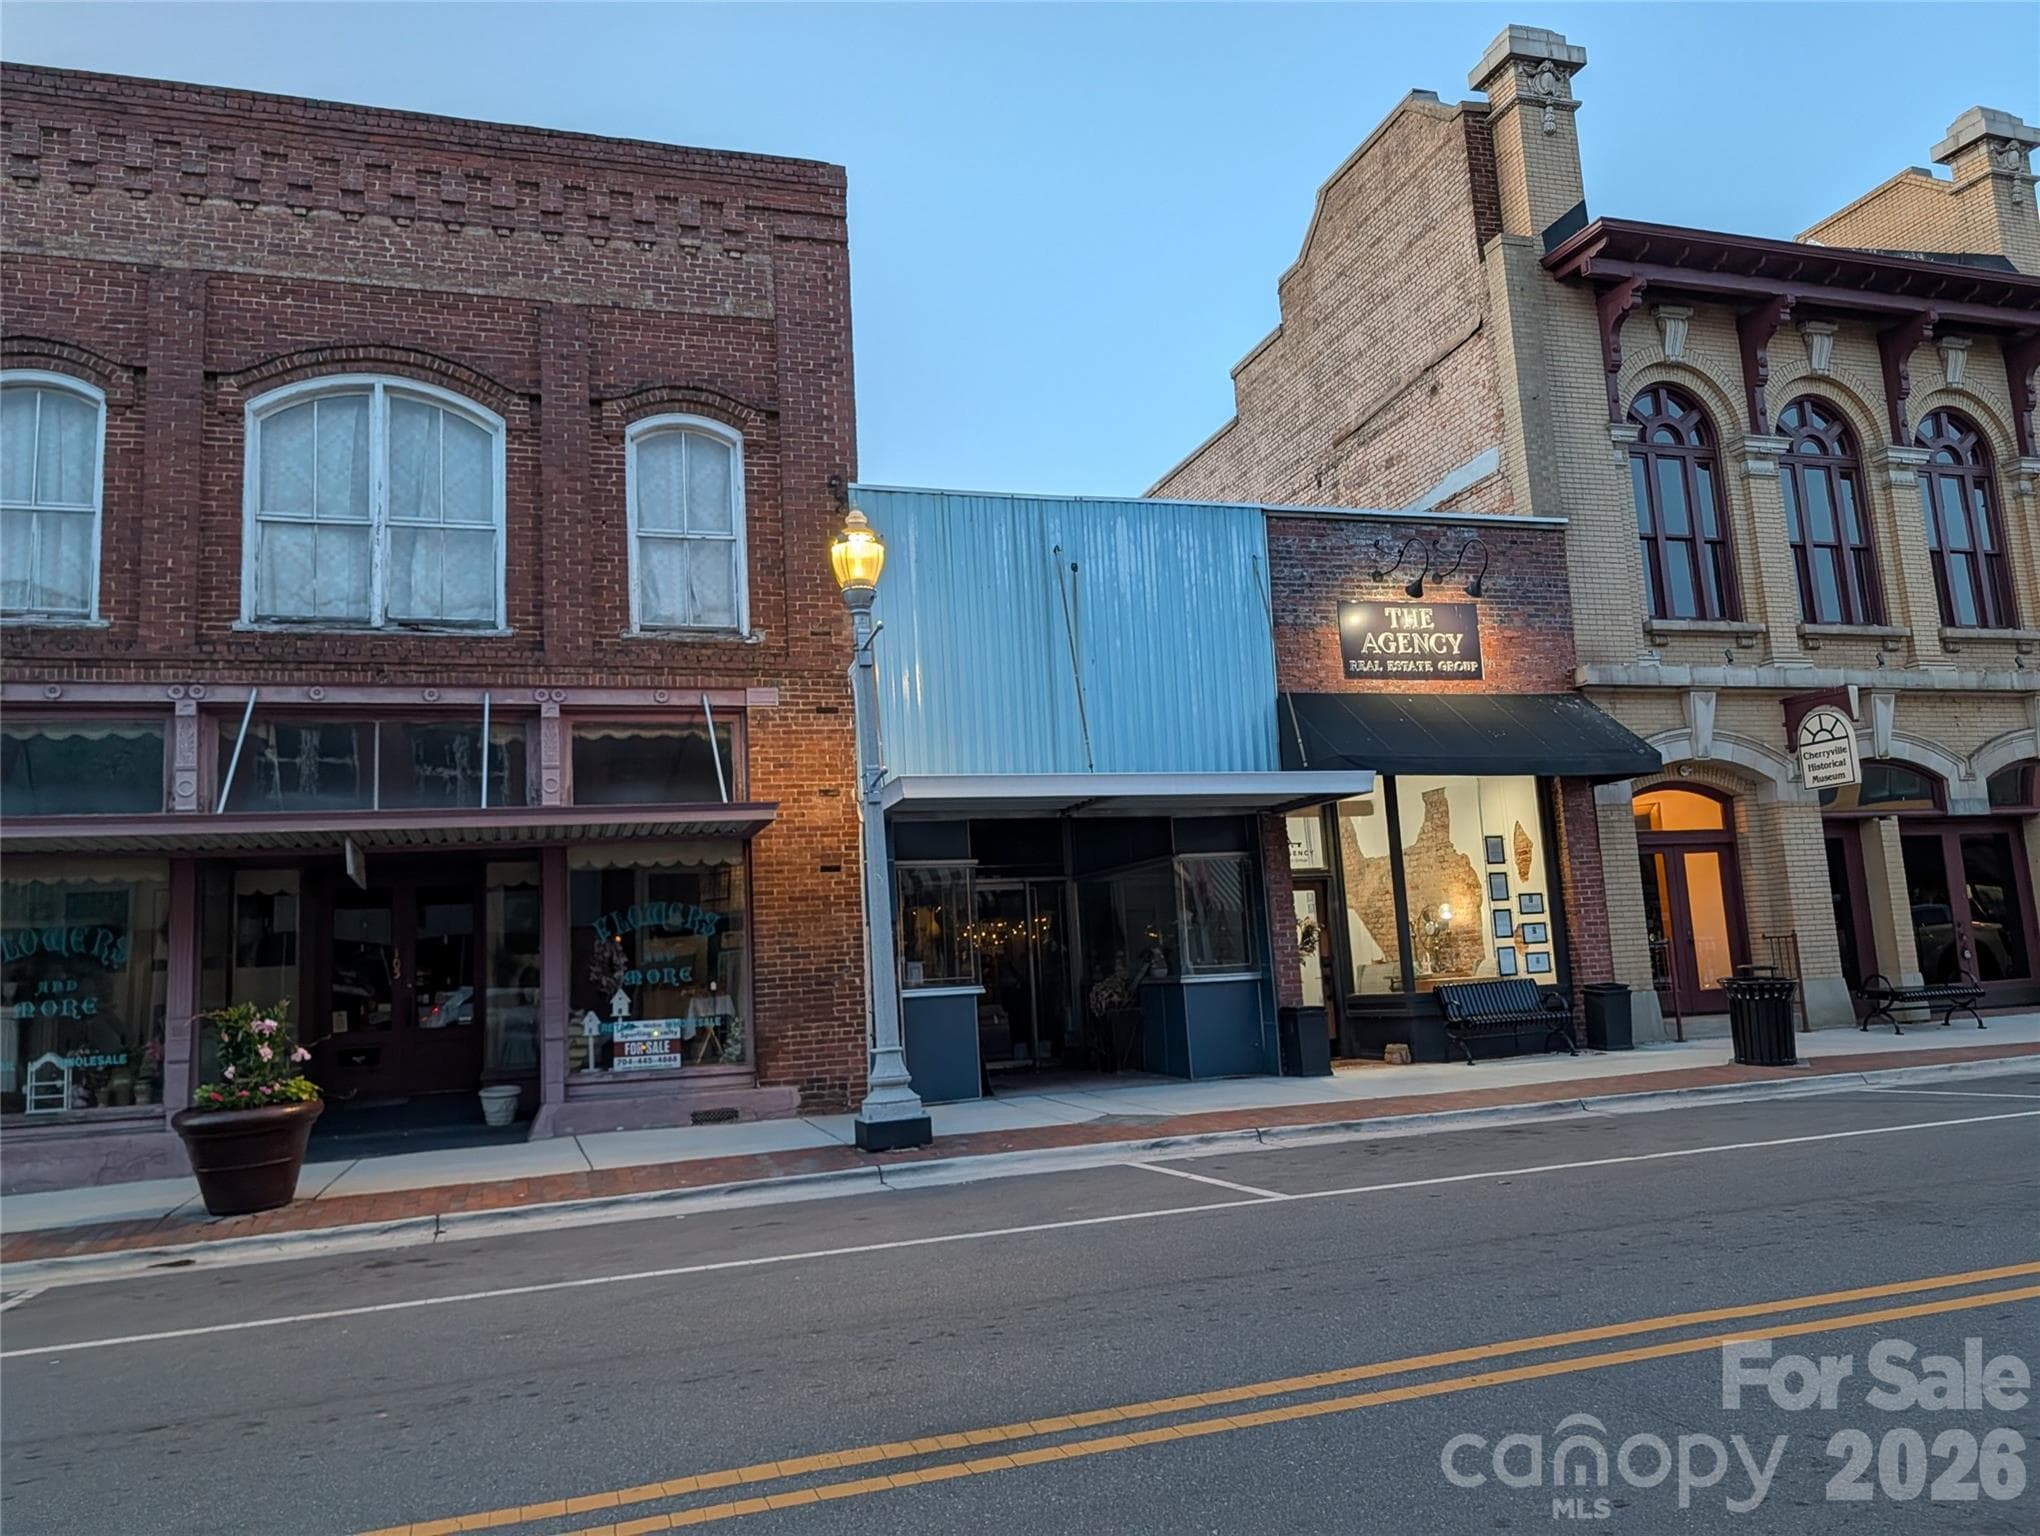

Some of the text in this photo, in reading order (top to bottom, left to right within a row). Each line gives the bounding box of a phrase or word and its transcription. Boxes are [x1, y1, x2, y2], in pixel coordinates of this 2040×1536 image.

[1384, 607, 1435, 630] THE
[1360, 632, 1464, 655] AGENCY
[1349, 660, 1479, 672] REAL ESTATE GROUP
[1803, 747, 1847, 759] Cherryville
[1808, 758, 1846, 771] Historical
[1812, 773, 1845, 783] Museum
[623, 966, 693, 986] MORE
[34, 979, 79, 996] AND
[14, 997, 97, 1018] MORE
[624, 1040, 671, 1056] FOR SALE
